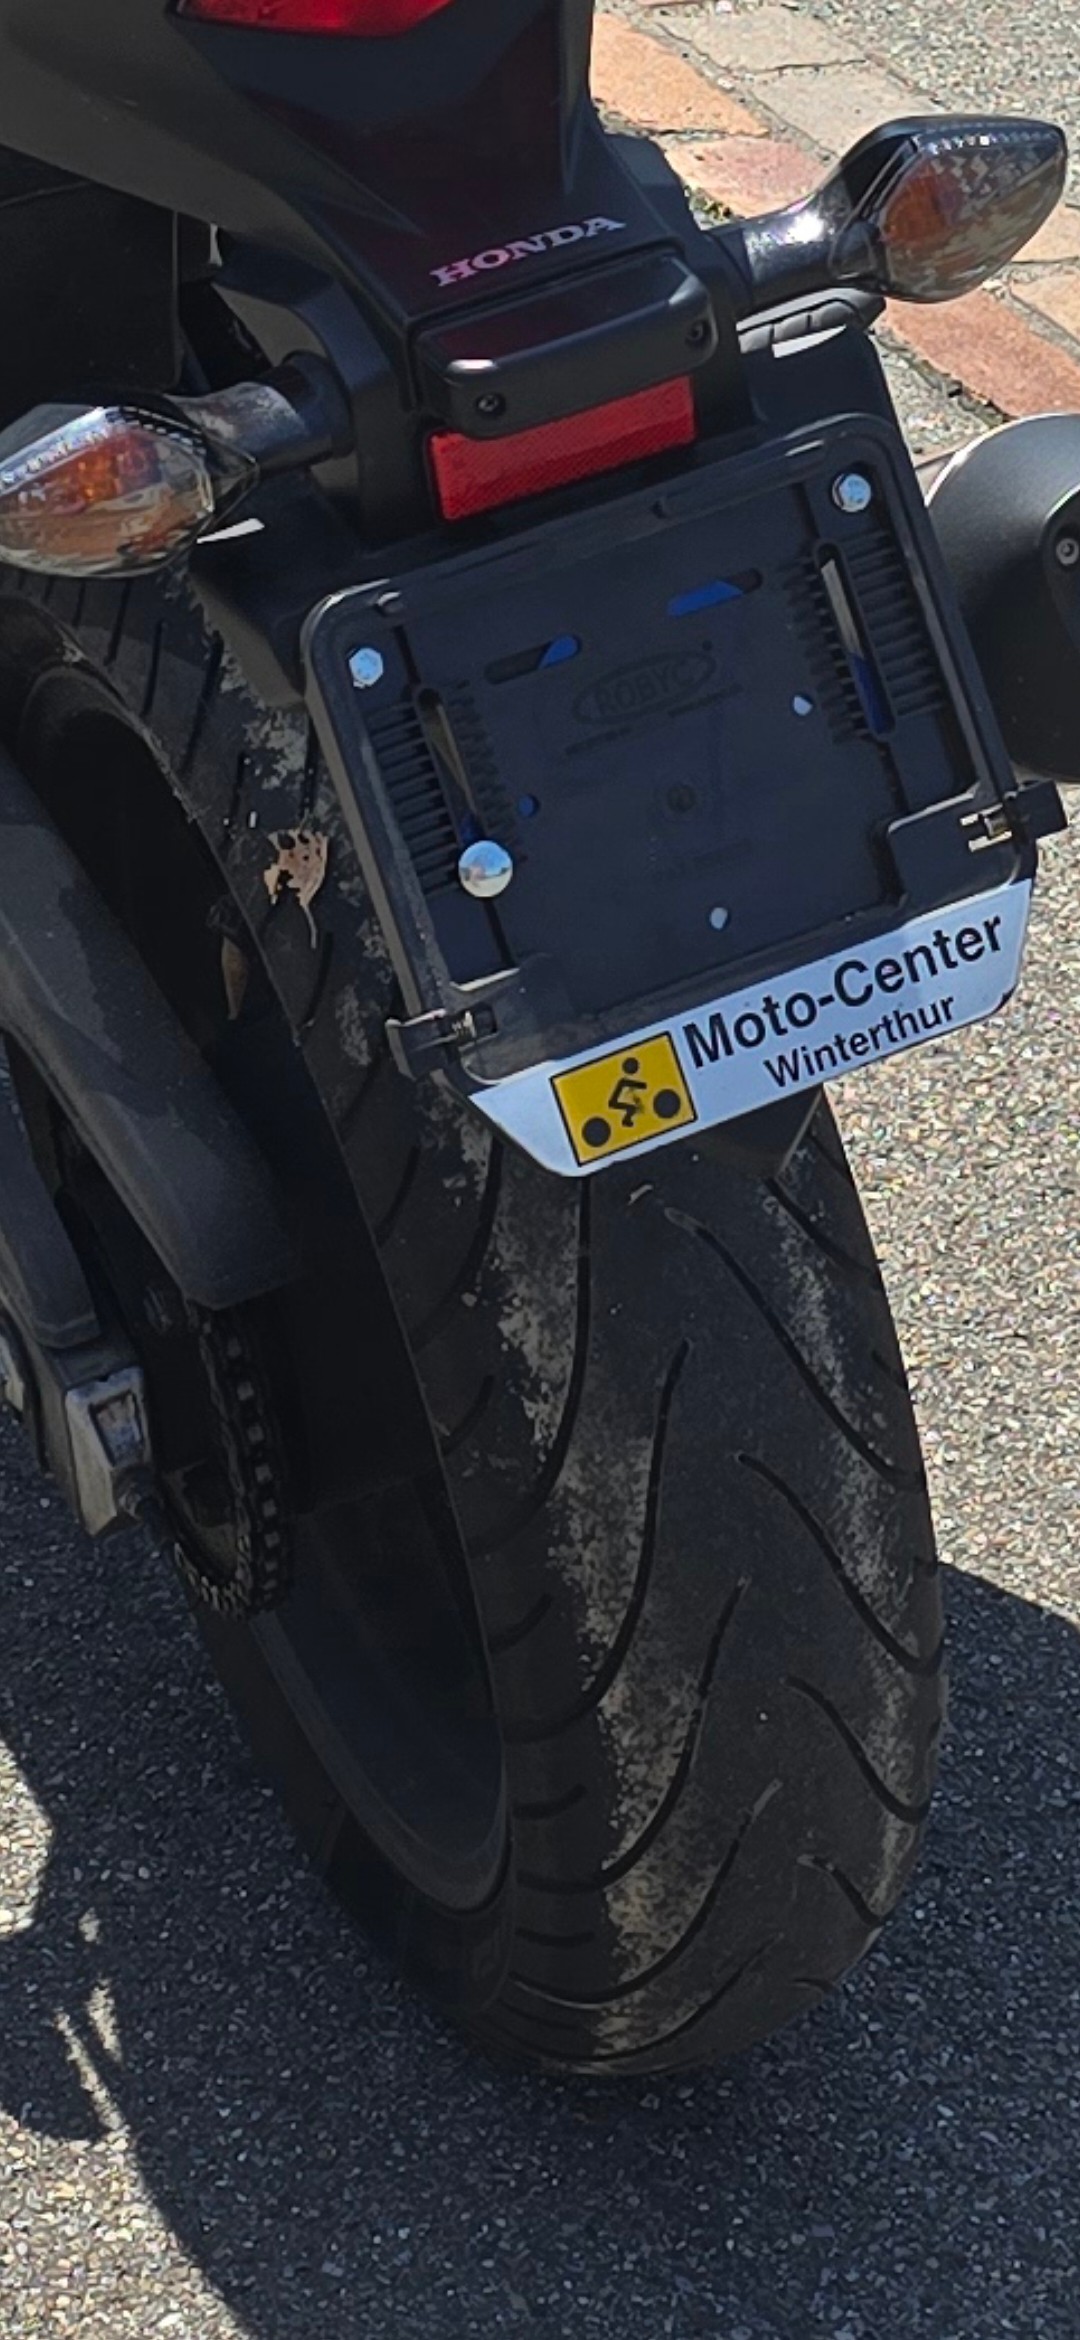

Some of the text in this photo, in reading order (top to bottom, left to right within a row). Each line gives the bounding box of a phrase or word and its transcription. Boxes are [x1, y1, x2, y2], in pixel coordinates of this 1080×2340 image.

[430, 216, 626, 287] HONDA
[683, 915, 1001, 1069] Moto-Center
[764, 996, 954, 1088] Winterthur
